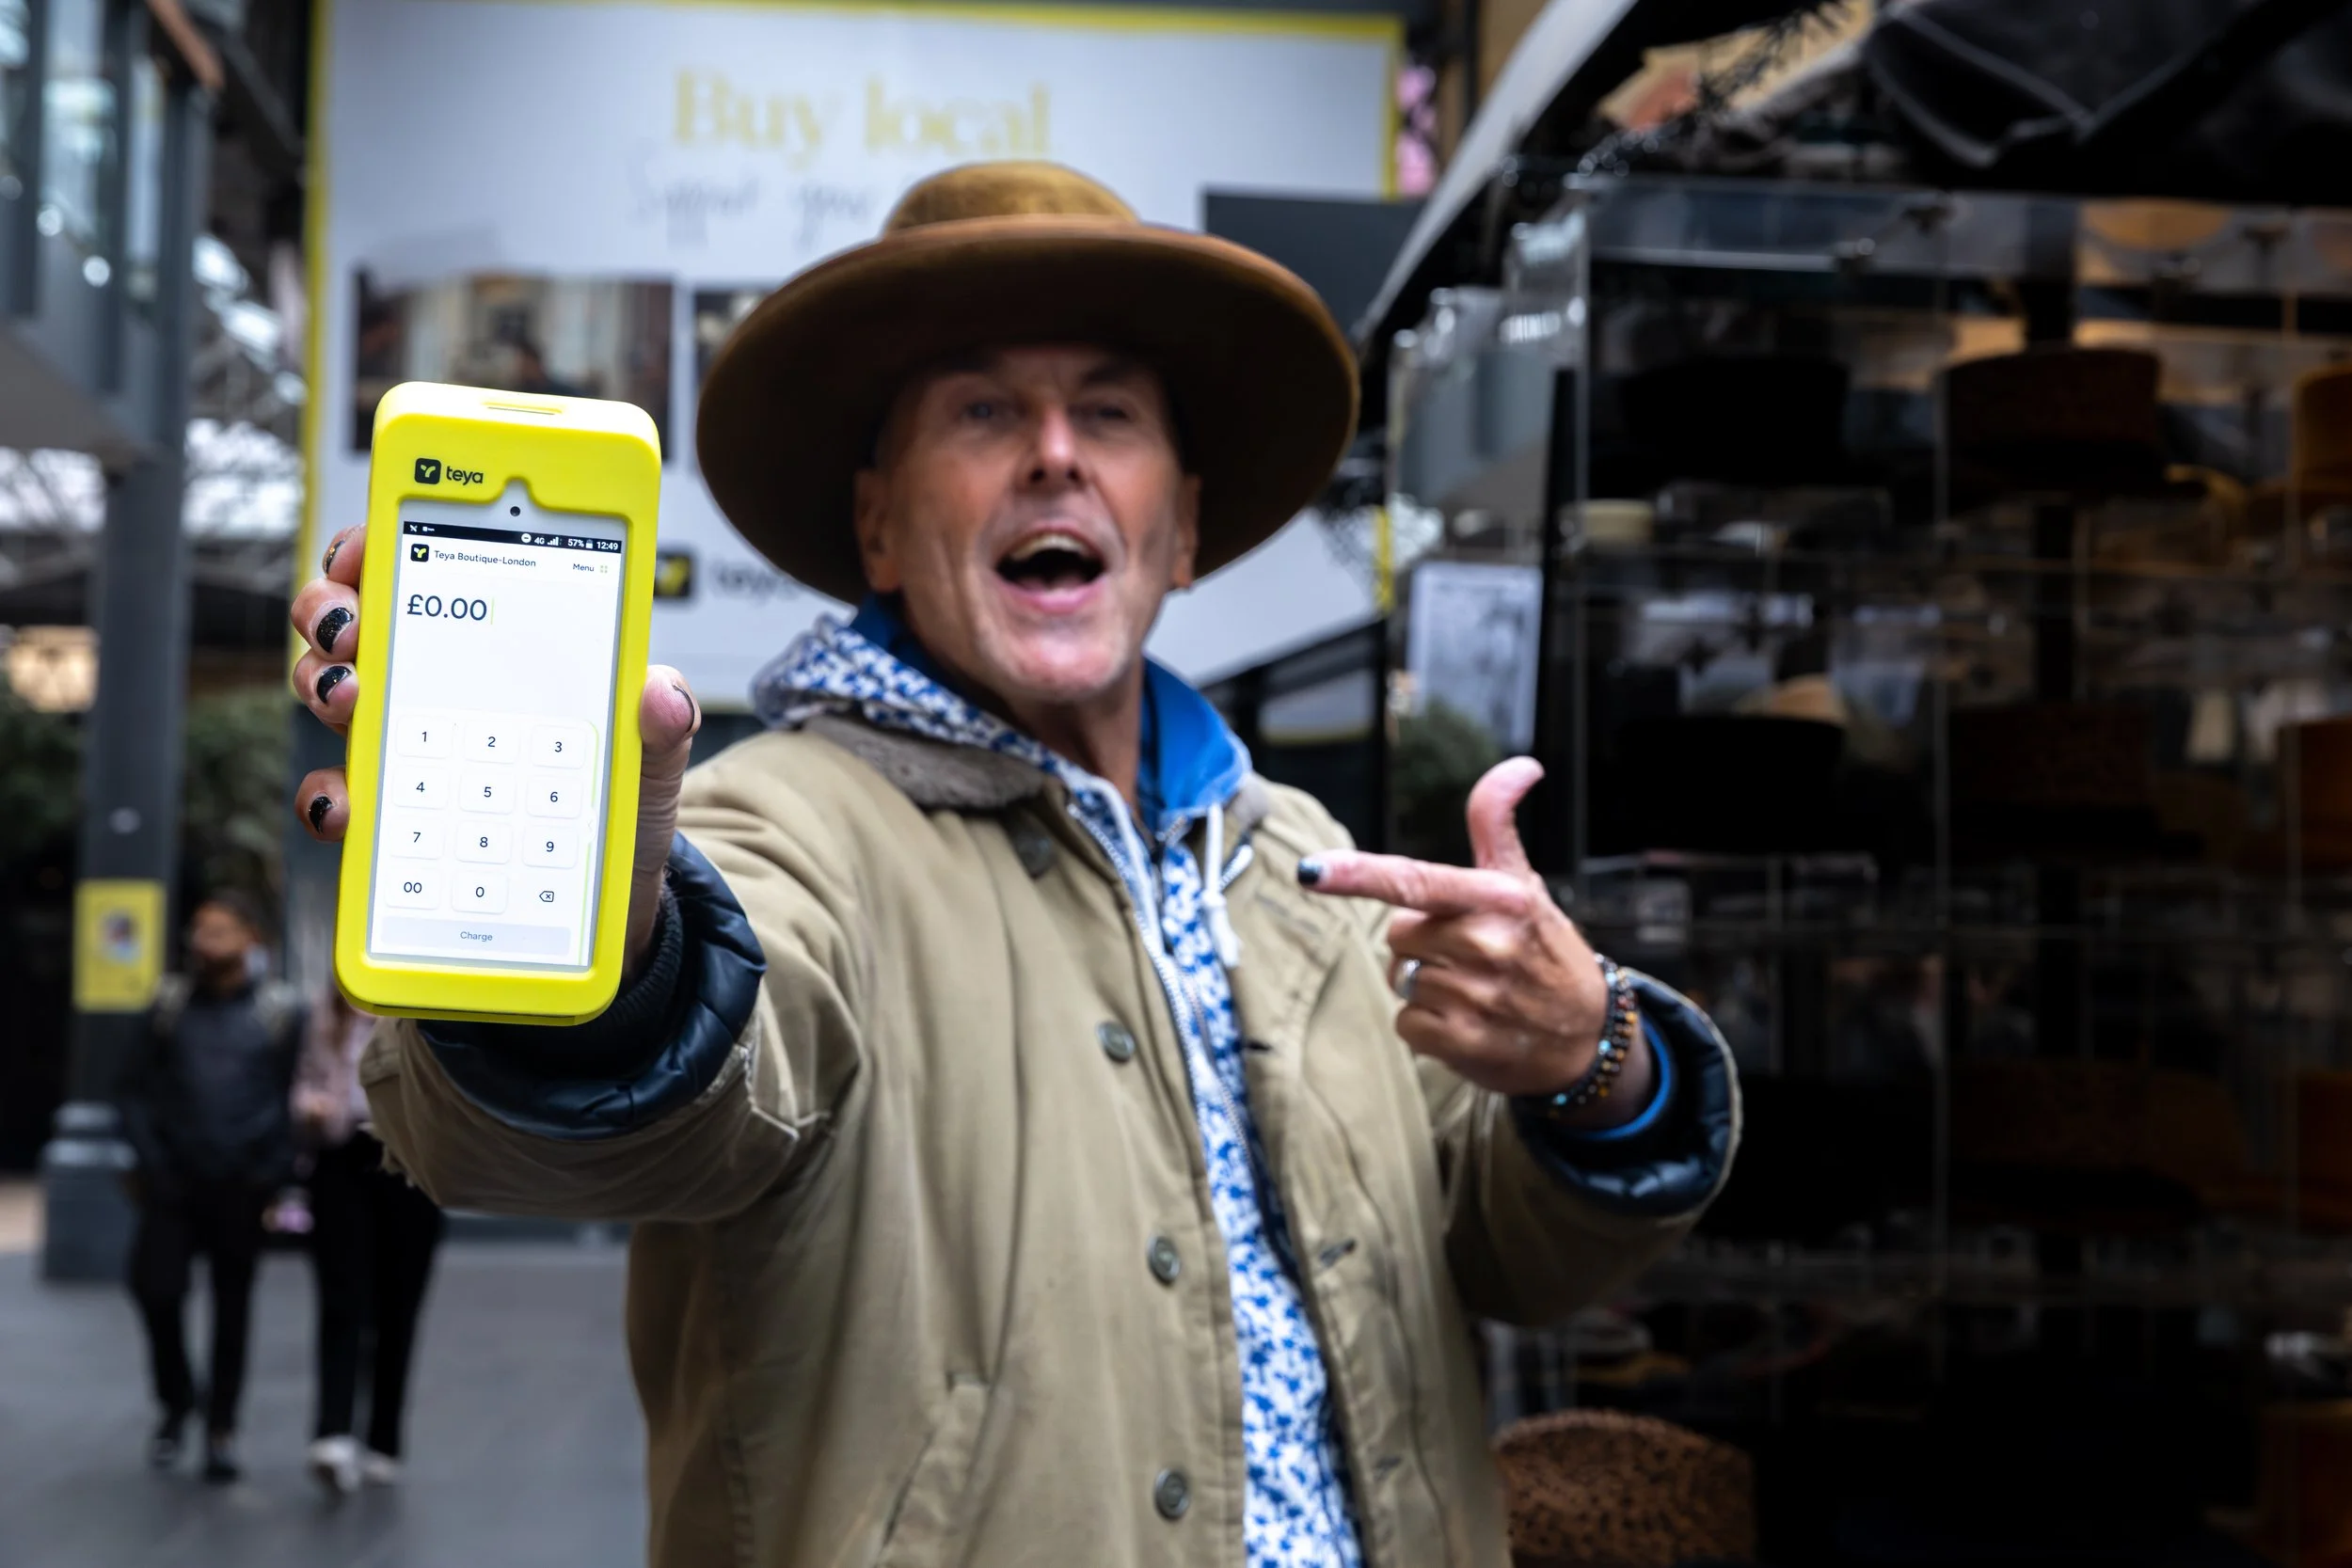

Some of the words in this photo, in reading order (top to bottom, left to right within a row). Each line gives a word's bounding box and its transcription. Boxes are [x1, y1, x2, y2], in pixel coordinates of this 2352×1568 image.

[672, 66, 836, 173] Buy
[864, 70, 1052, 156] local
[446, 466, 484, 486] teya
[533, 536, 546, 546] 4G
[567, 538, 584, 548] 57%
[596, 541, 619, 551] 12:49
[434, 549, 455, 562] Teya
[457, 553, 536, 567] Boutique-London
[572, 563, 595, 573] Menu
[406, 594, 487, 621] £0.00
[421, 731, 428, 742] 1
[487, 736, 496, 748] 2
[554, 741, 563, 752] 3
[416, 782, 425, 793] 4
[484, 786, 492, 798] 5
[549, 791, 559, 802] 6
[413, 832, 421, 843] 7
[479, 836, 488, 847] 8
[546, 841, 554, 852] 9
[403, 881, 422, 894] 00
[475, 886, 485, 898] 0
[459, 930, 493, 943] Charge
